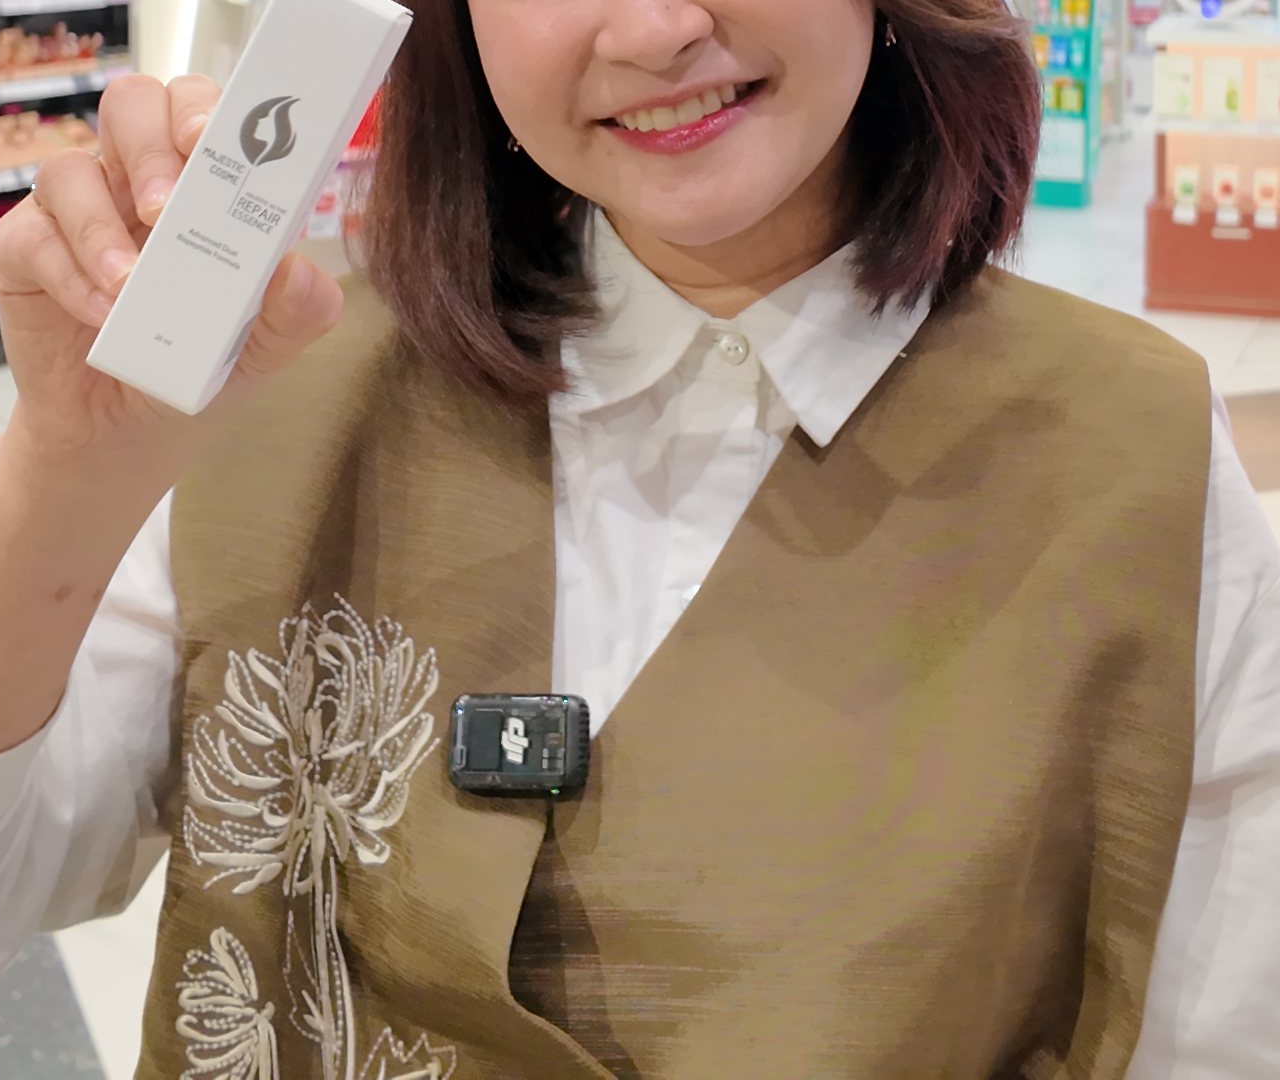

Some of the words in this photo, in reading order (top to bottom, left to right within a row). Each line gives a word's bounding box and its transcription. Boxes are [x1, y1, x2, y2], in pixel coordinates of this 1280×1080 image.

[202, 146, 246, 174] MAJESTIC
[209, 163, 240, 186] COSME
[231, 208, 274, 235] ESSENCE
[236, 196, 281, 226] REPAIR
